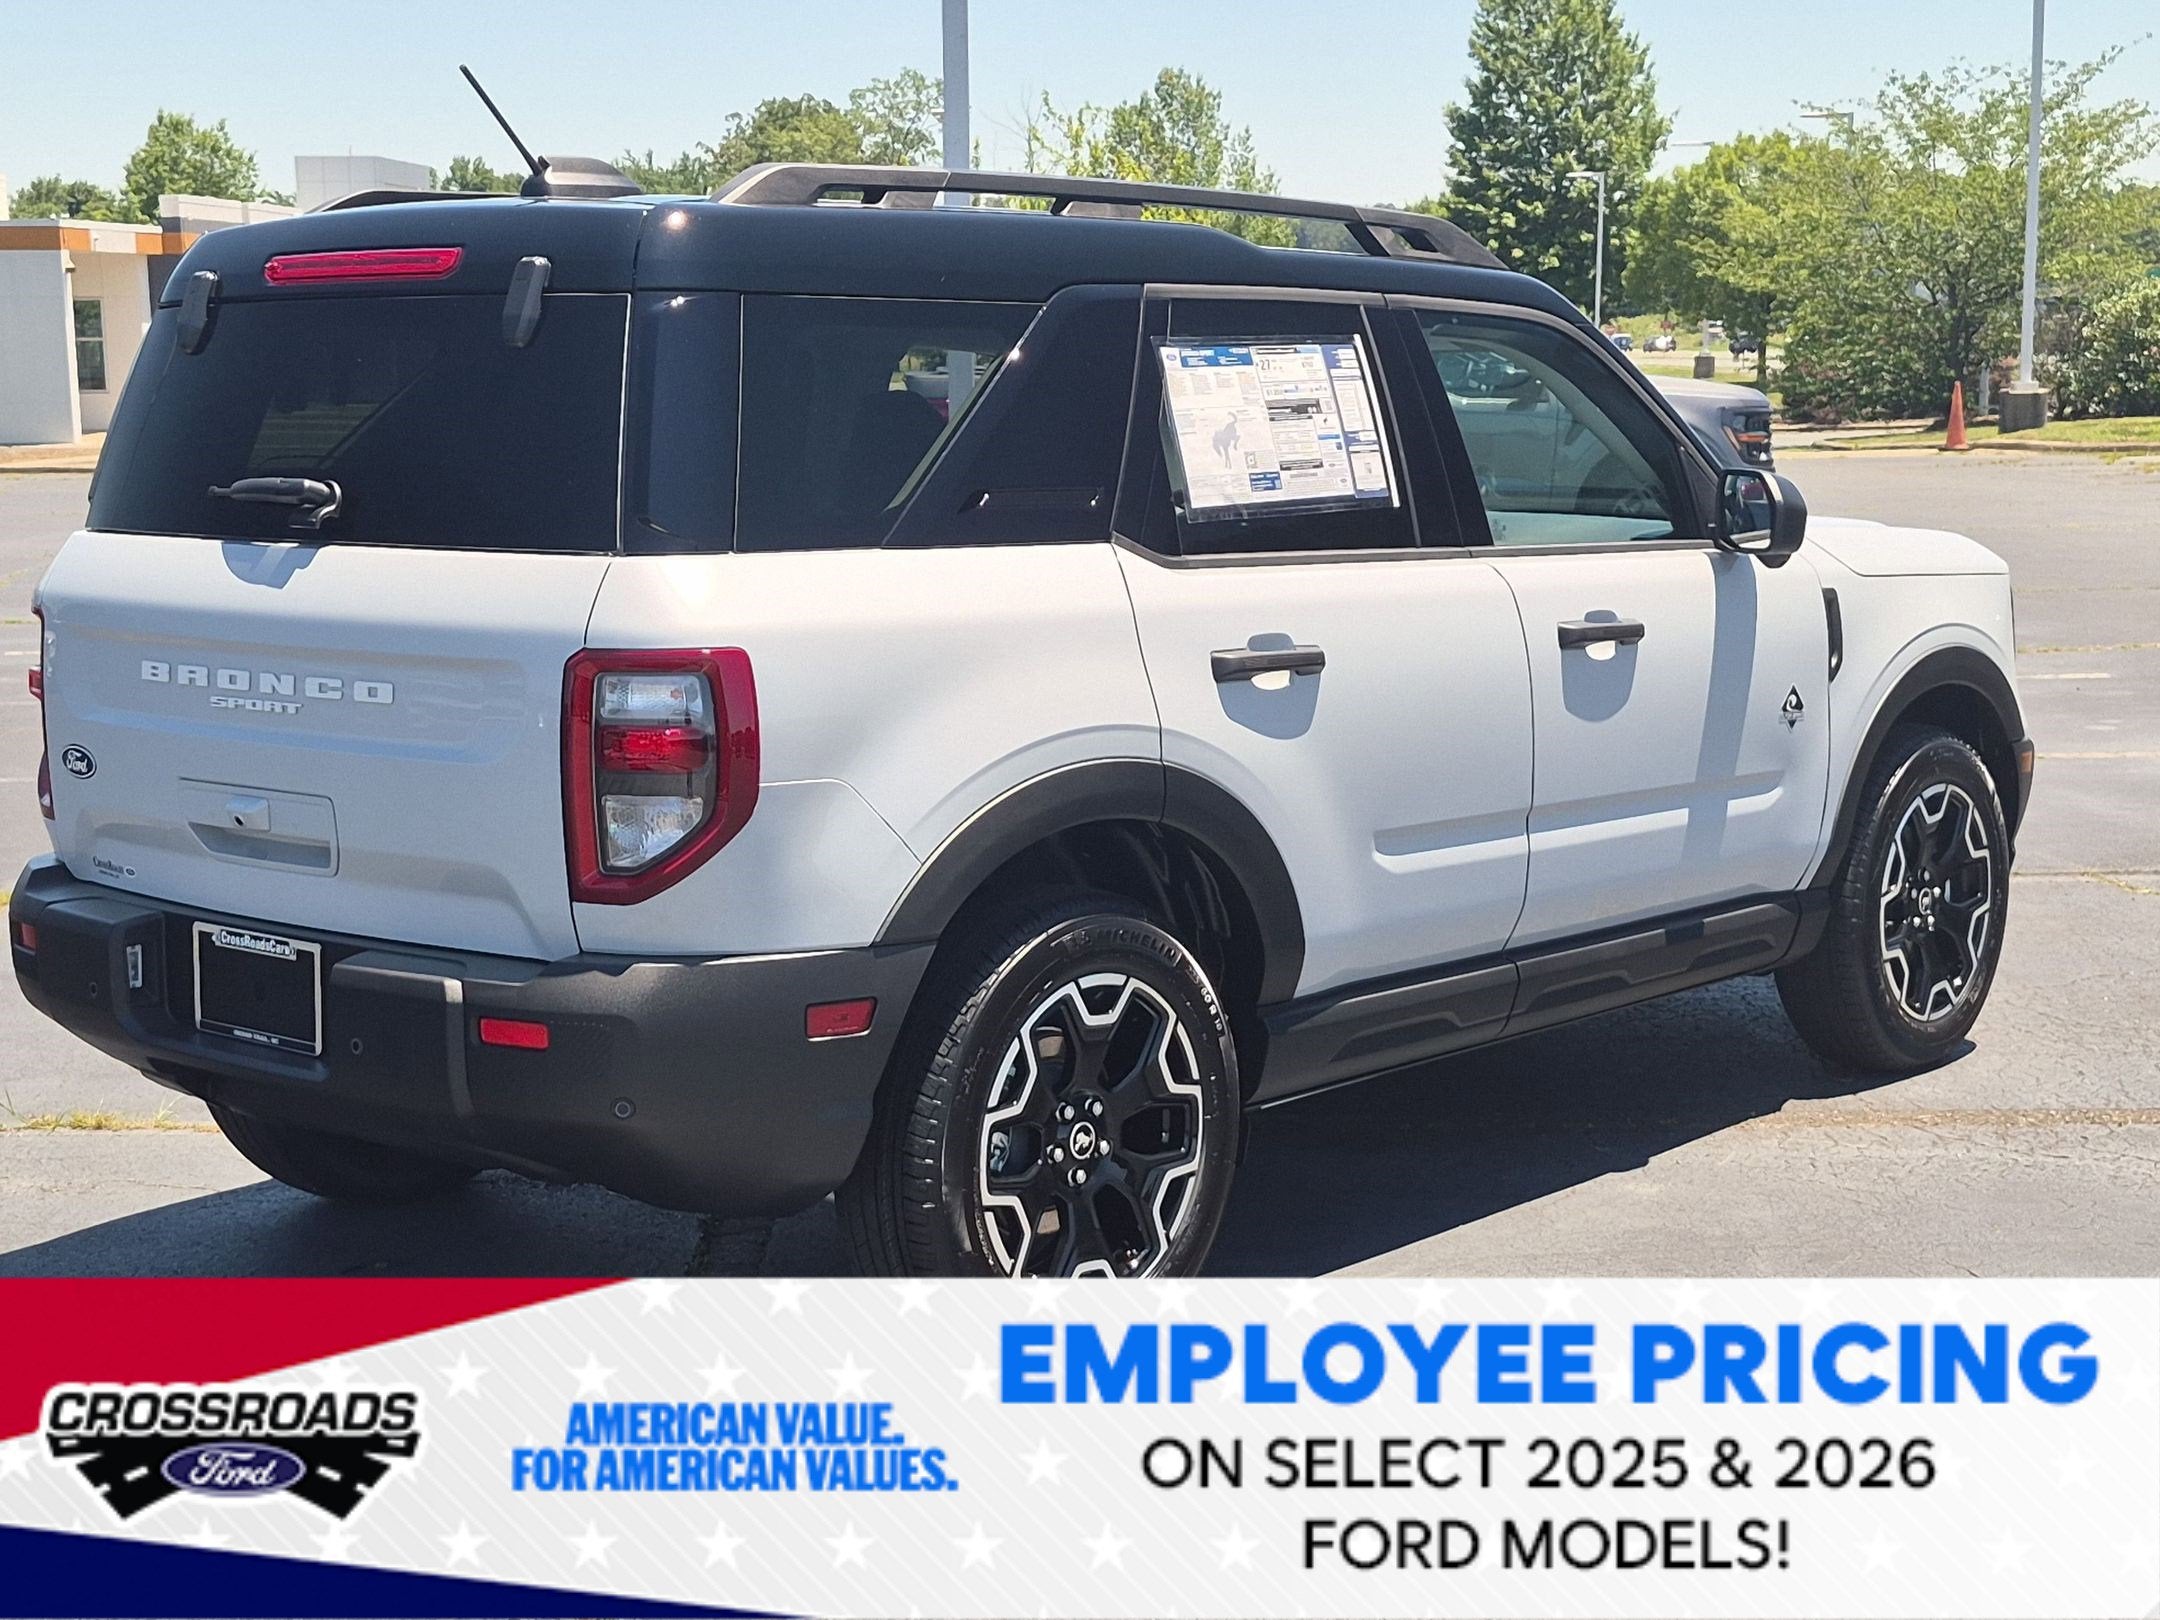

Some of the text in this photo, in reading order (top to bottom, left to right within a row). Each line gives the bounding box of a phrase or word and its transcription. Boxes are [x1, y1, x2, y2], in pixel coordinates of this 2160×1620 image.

[141, 659, 395, 705] BRONCO
[209, 695, 303, 715] SPORT
[1096, 926, 1177, 961] MICHELIN
